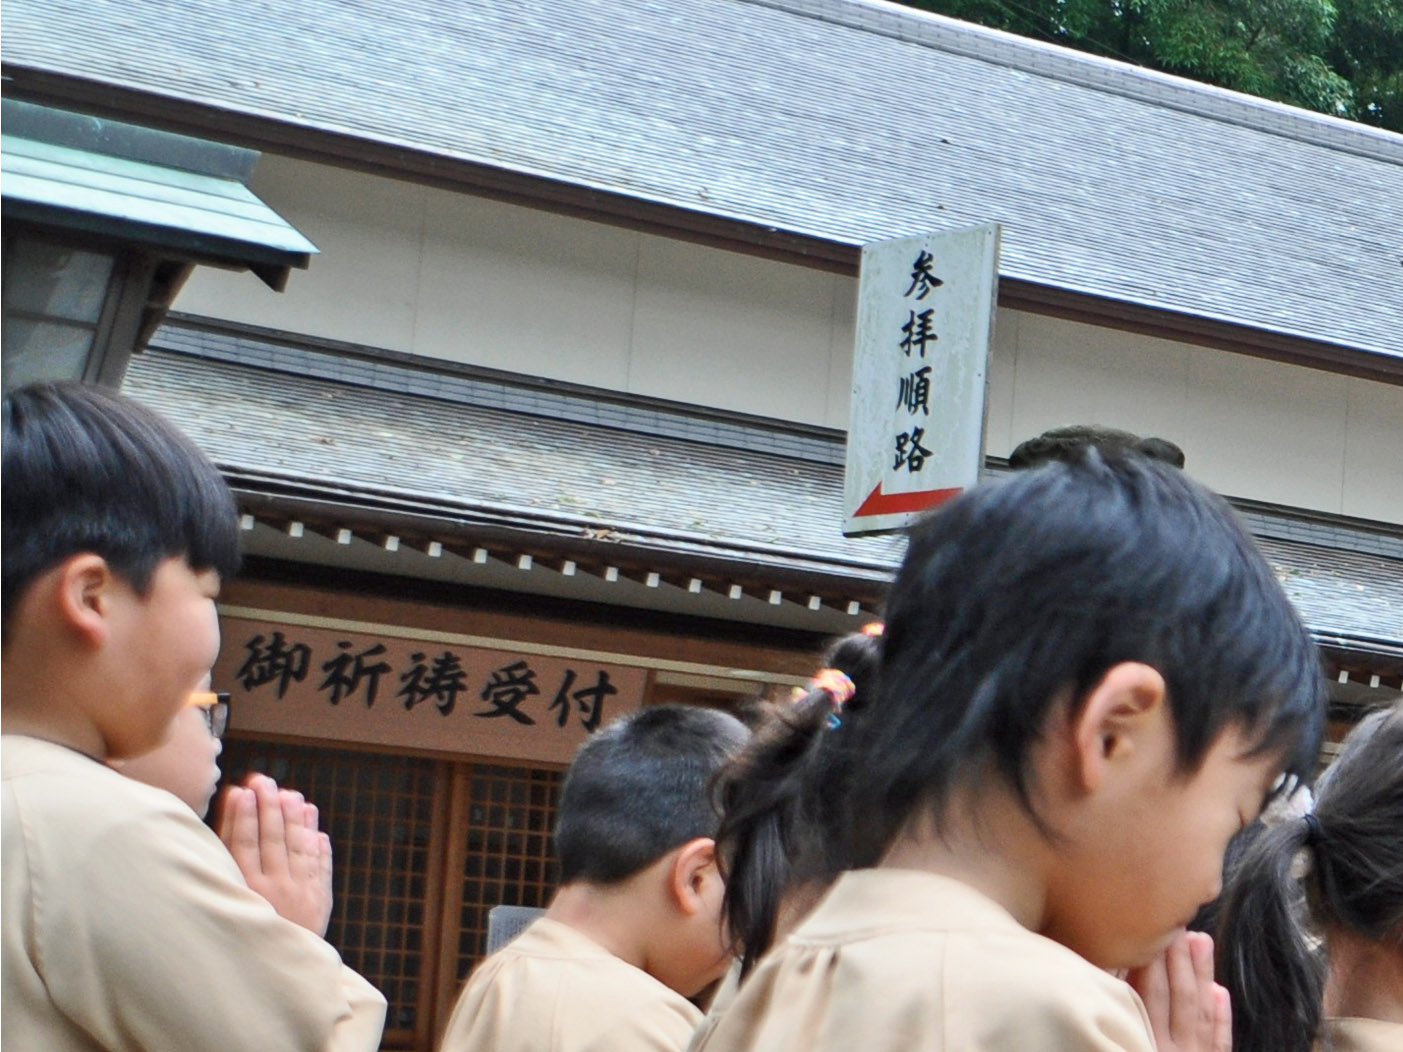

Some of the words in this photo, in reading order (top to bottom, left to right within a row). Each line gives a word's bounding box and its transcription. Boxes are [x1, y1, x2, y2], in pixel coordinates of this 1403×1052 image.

[893, 249, 945, 474] 参拝順路
[235, 632, 619, 732] 御祈祷受付
